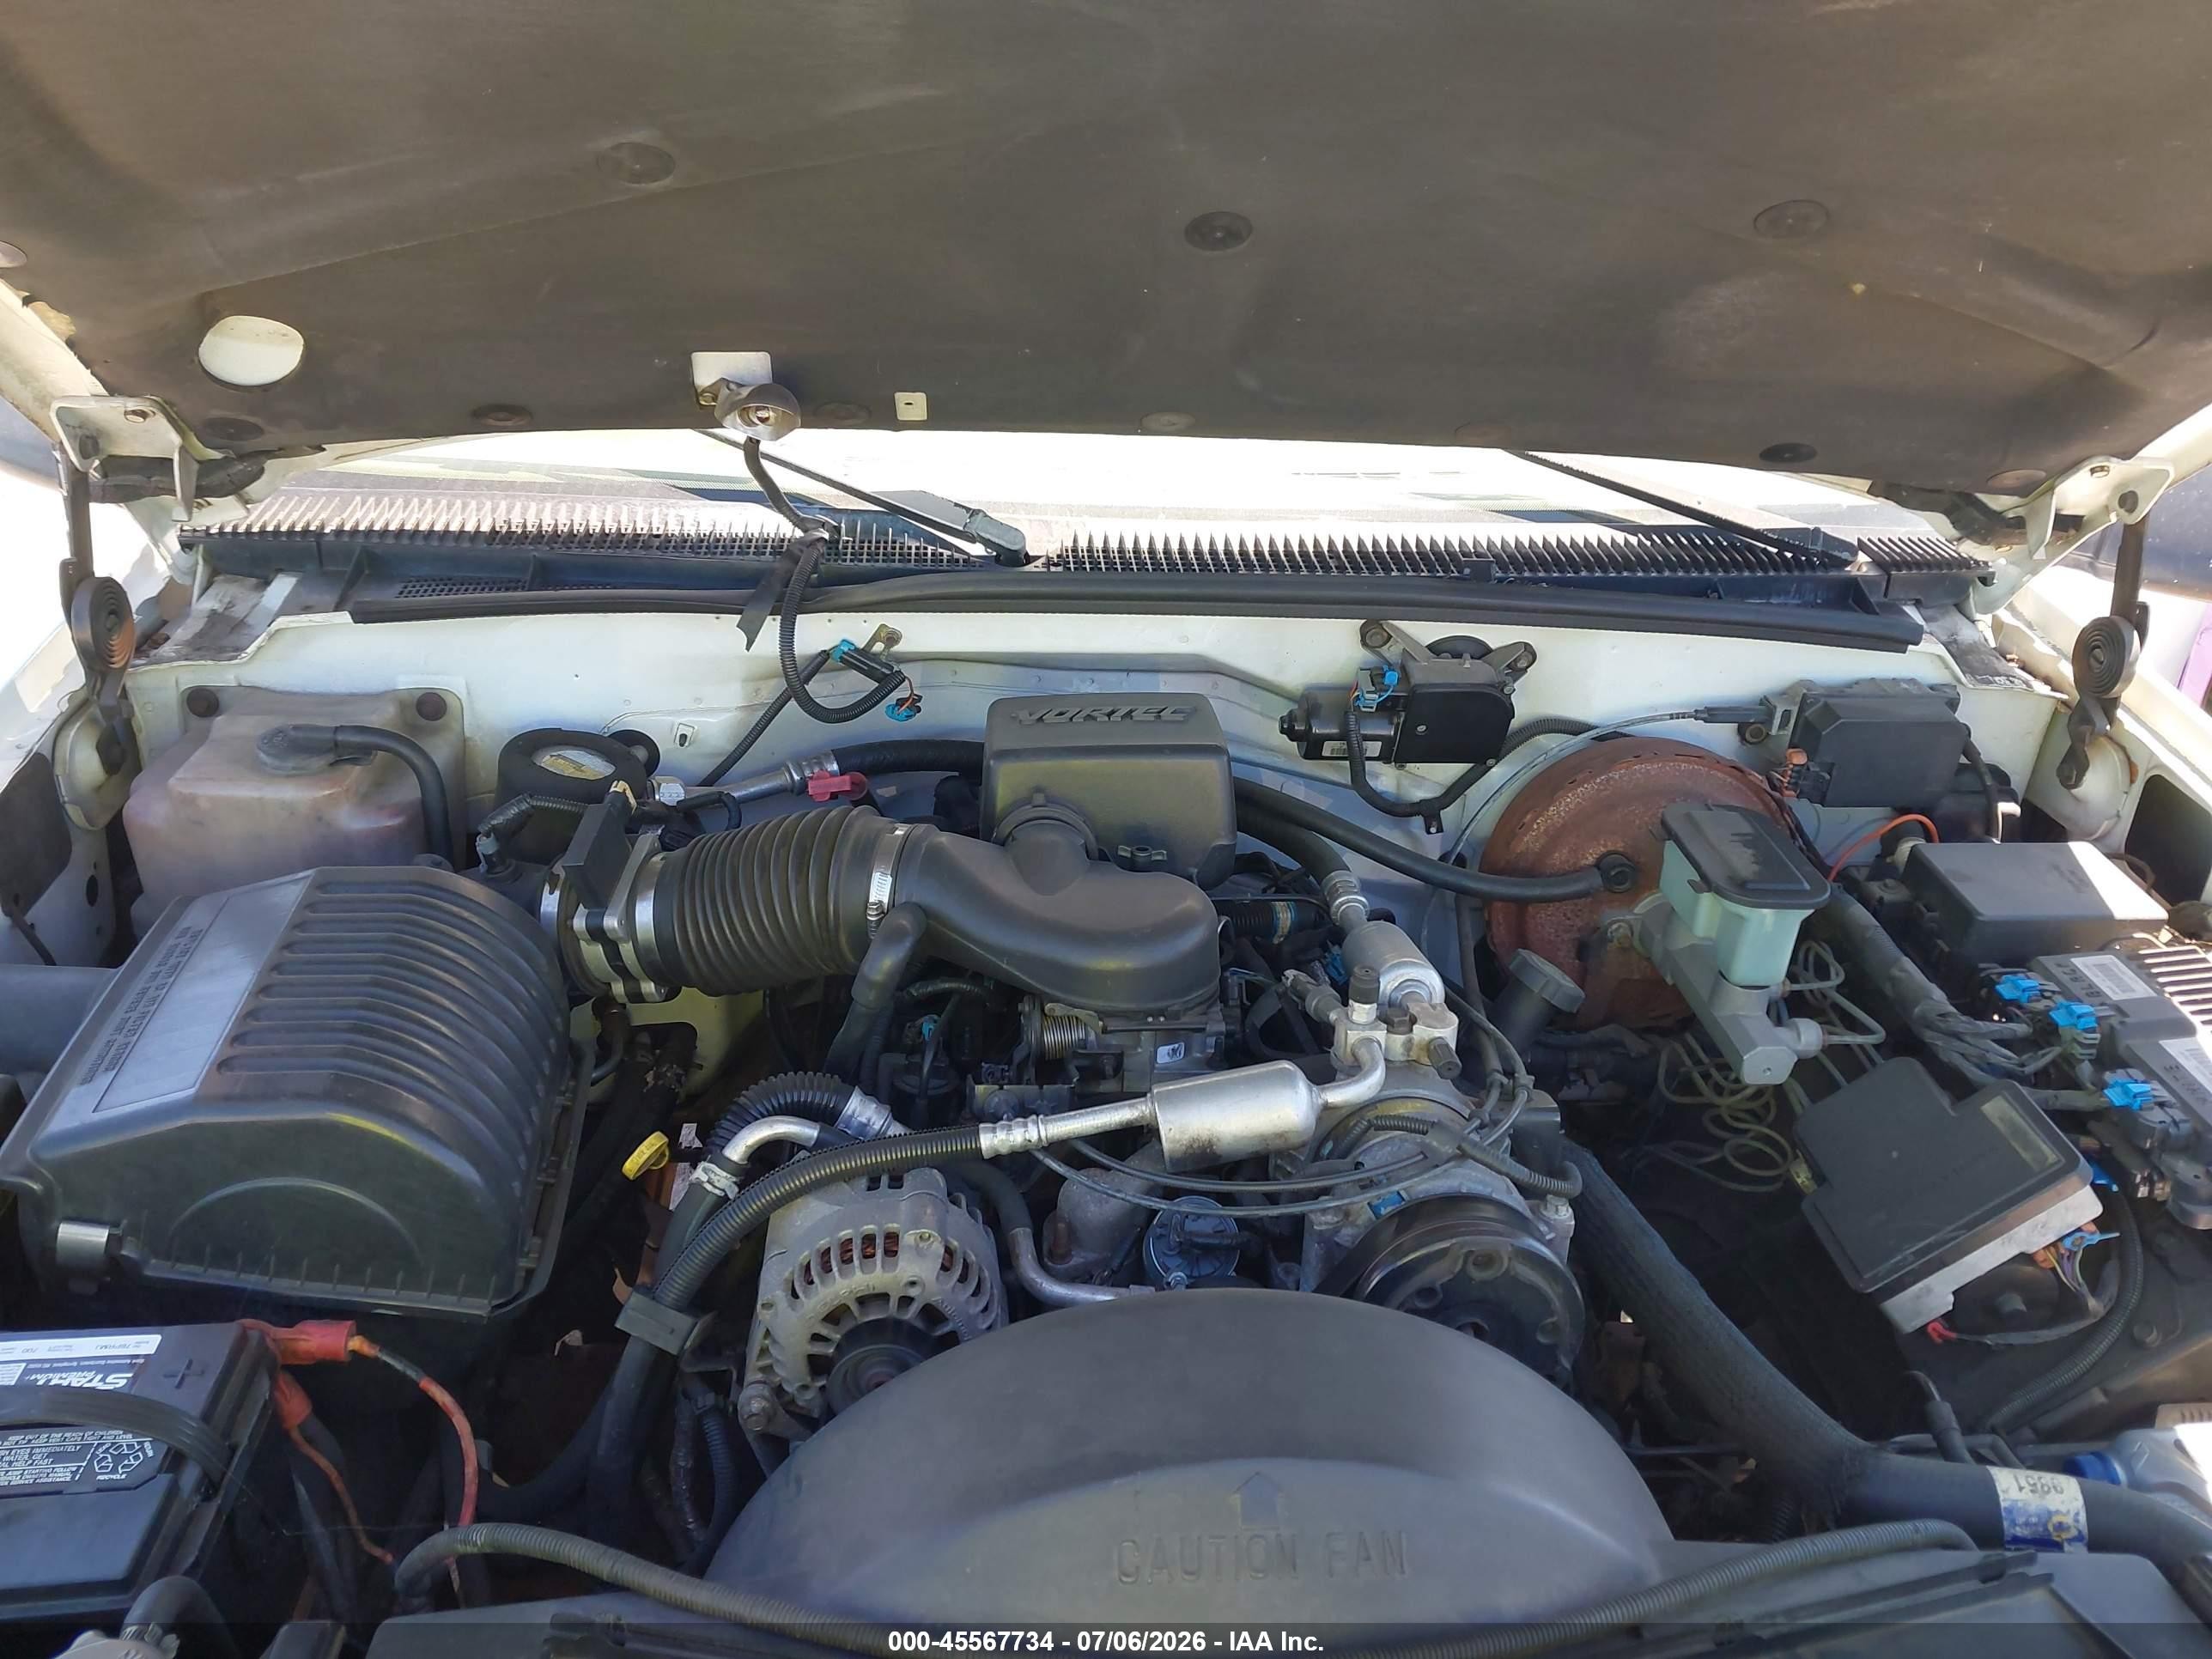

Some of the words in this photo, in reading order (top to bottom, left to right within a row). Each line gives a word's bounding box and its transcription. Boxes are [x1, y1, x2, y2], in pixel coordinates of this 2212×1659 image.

[32, 1445, 82, 1454] IMMEDIATELY
[1114, 1534, 1299, 1586] CAUTION
[1325, 1528, 1410, 1580] FAN
